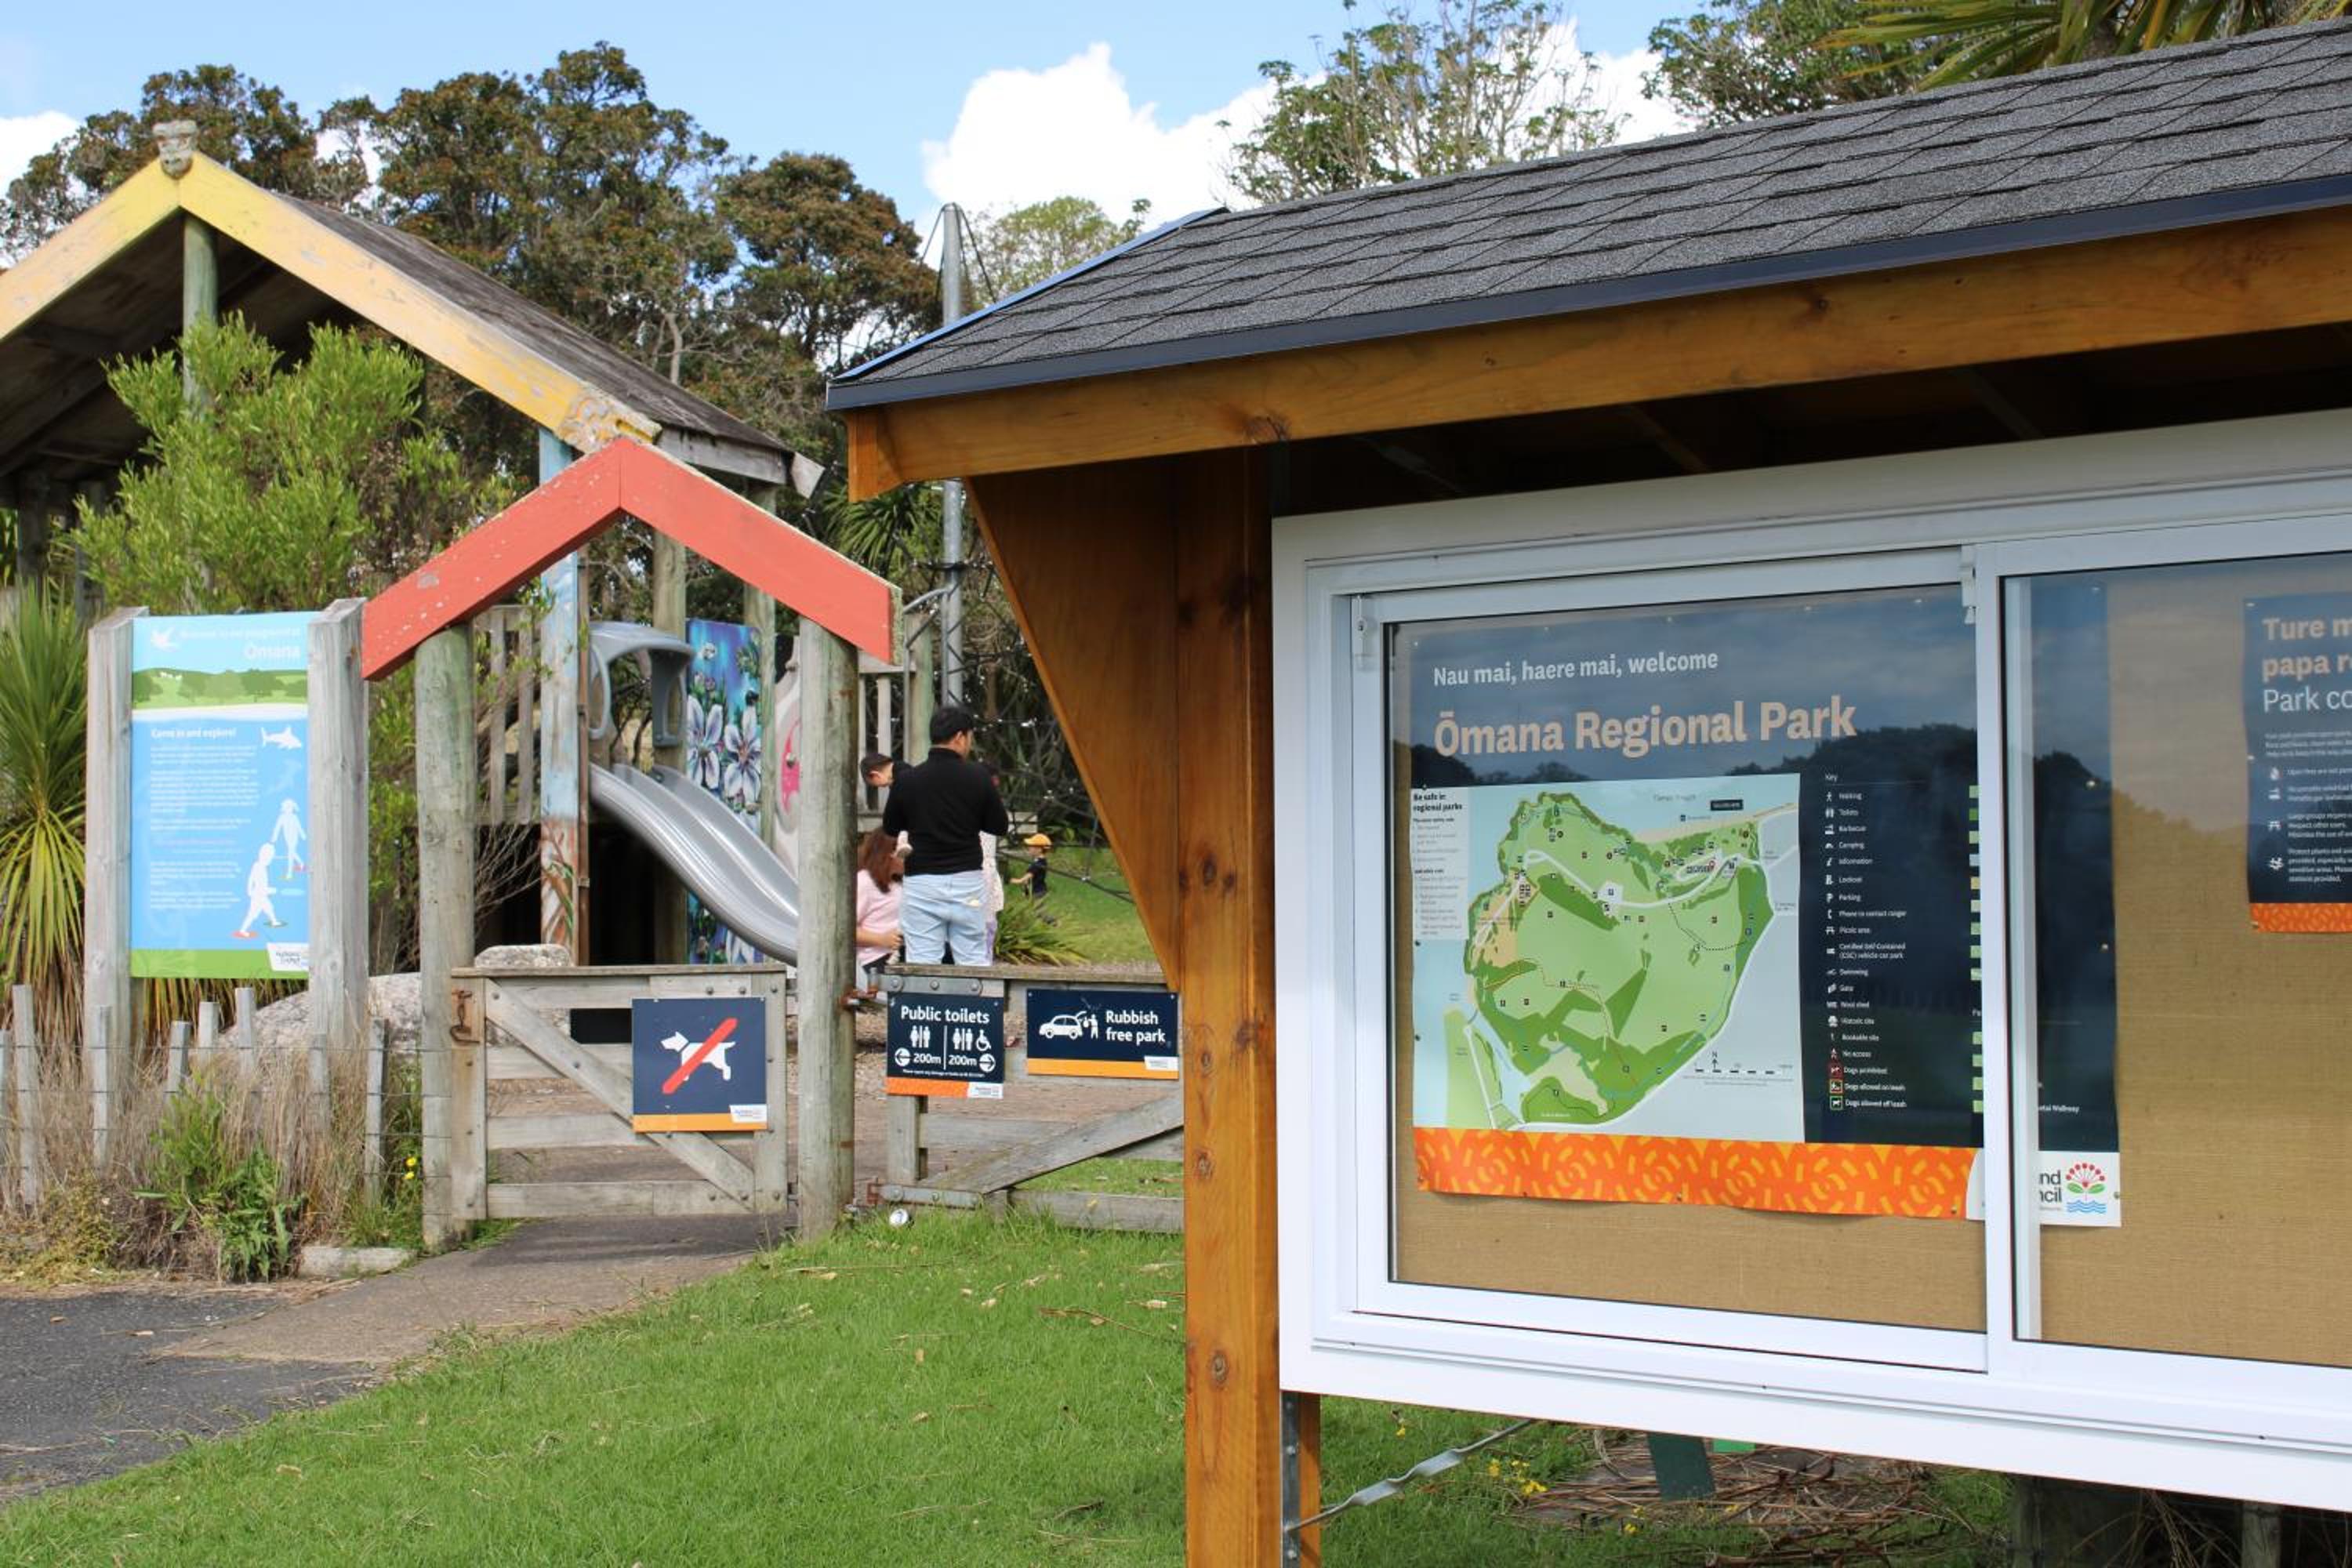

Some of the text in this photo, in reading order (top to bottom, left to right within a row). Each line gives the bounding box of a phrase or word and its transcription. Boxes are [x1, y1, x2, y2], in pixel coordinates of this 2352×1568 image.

[2261, 616, 2352, 641] Ture m
[1433, 652, 1719, 687] Nau mai, haere mai, welcome
[2262, 654, 2331, 684] papa
[2263, 684, 2320, 713] Park
[1434, 695, 1858, 759] Ōmana Regional Park
[1825, 773, 1838, 783] Key
[1839, 841, 1865, 851] Camping
[1839, 857, 1873, 866] Information
[1839, 894, 1861, 902] Parking
[900, 1004, 990, 1025] Public toilets
[1105, 1009, 1159, 1025] Rubbish
[1105, 1027, 1166, 1047] free park
[913, 1052, 942, 1065] 200m
[948, 1054, 978, 1067] 200m
[1843, 1066, 1858, 1076] Dogs
[1844, 1083, 1859, 1092] Dogs
[1845, 1099, 1860, 1109] Dogs
